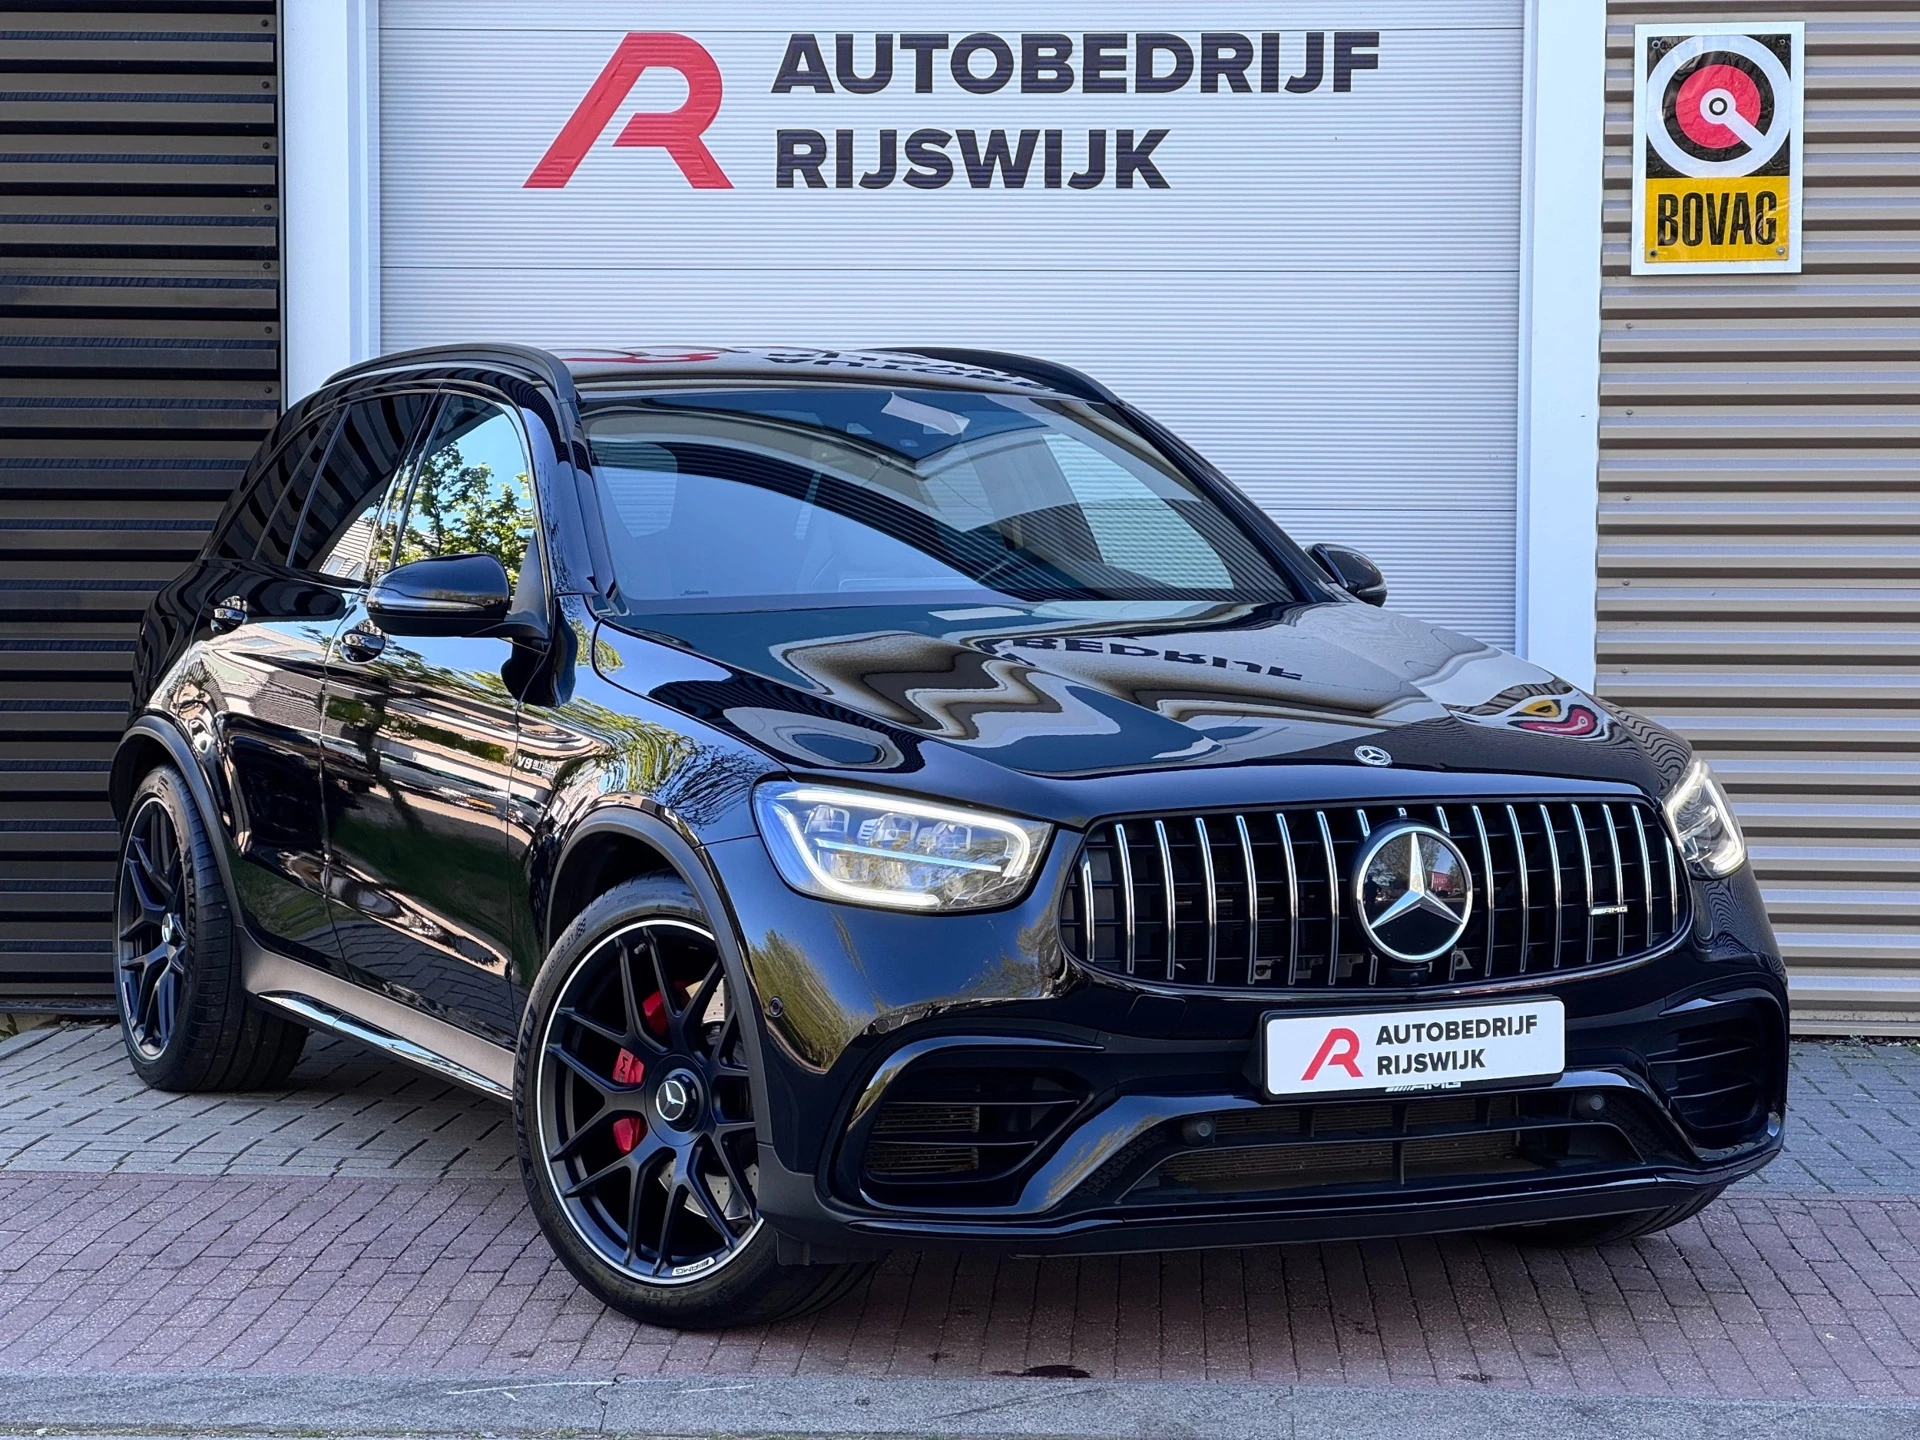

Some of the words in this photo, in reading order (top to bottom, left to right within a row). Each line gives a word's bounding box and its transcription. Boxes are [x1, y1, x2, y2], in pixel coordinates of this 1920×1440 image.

[771, 31, 1381, 94] AUTOBEDRIJF
[776, 128, 1171, 190] RIJSWIJK
[1657, 190, 1777, 247] BOVAG
[517, 756, 533, 769] V8
[1602, 906, 1628, 914] AMG
[1376, 1014, 1538, 1046] AUTOBEDRIJF
[516, 1003, 536, 1160] MICHELIN
[1377, 1048, 1486, 1076] RIJSWIJK
